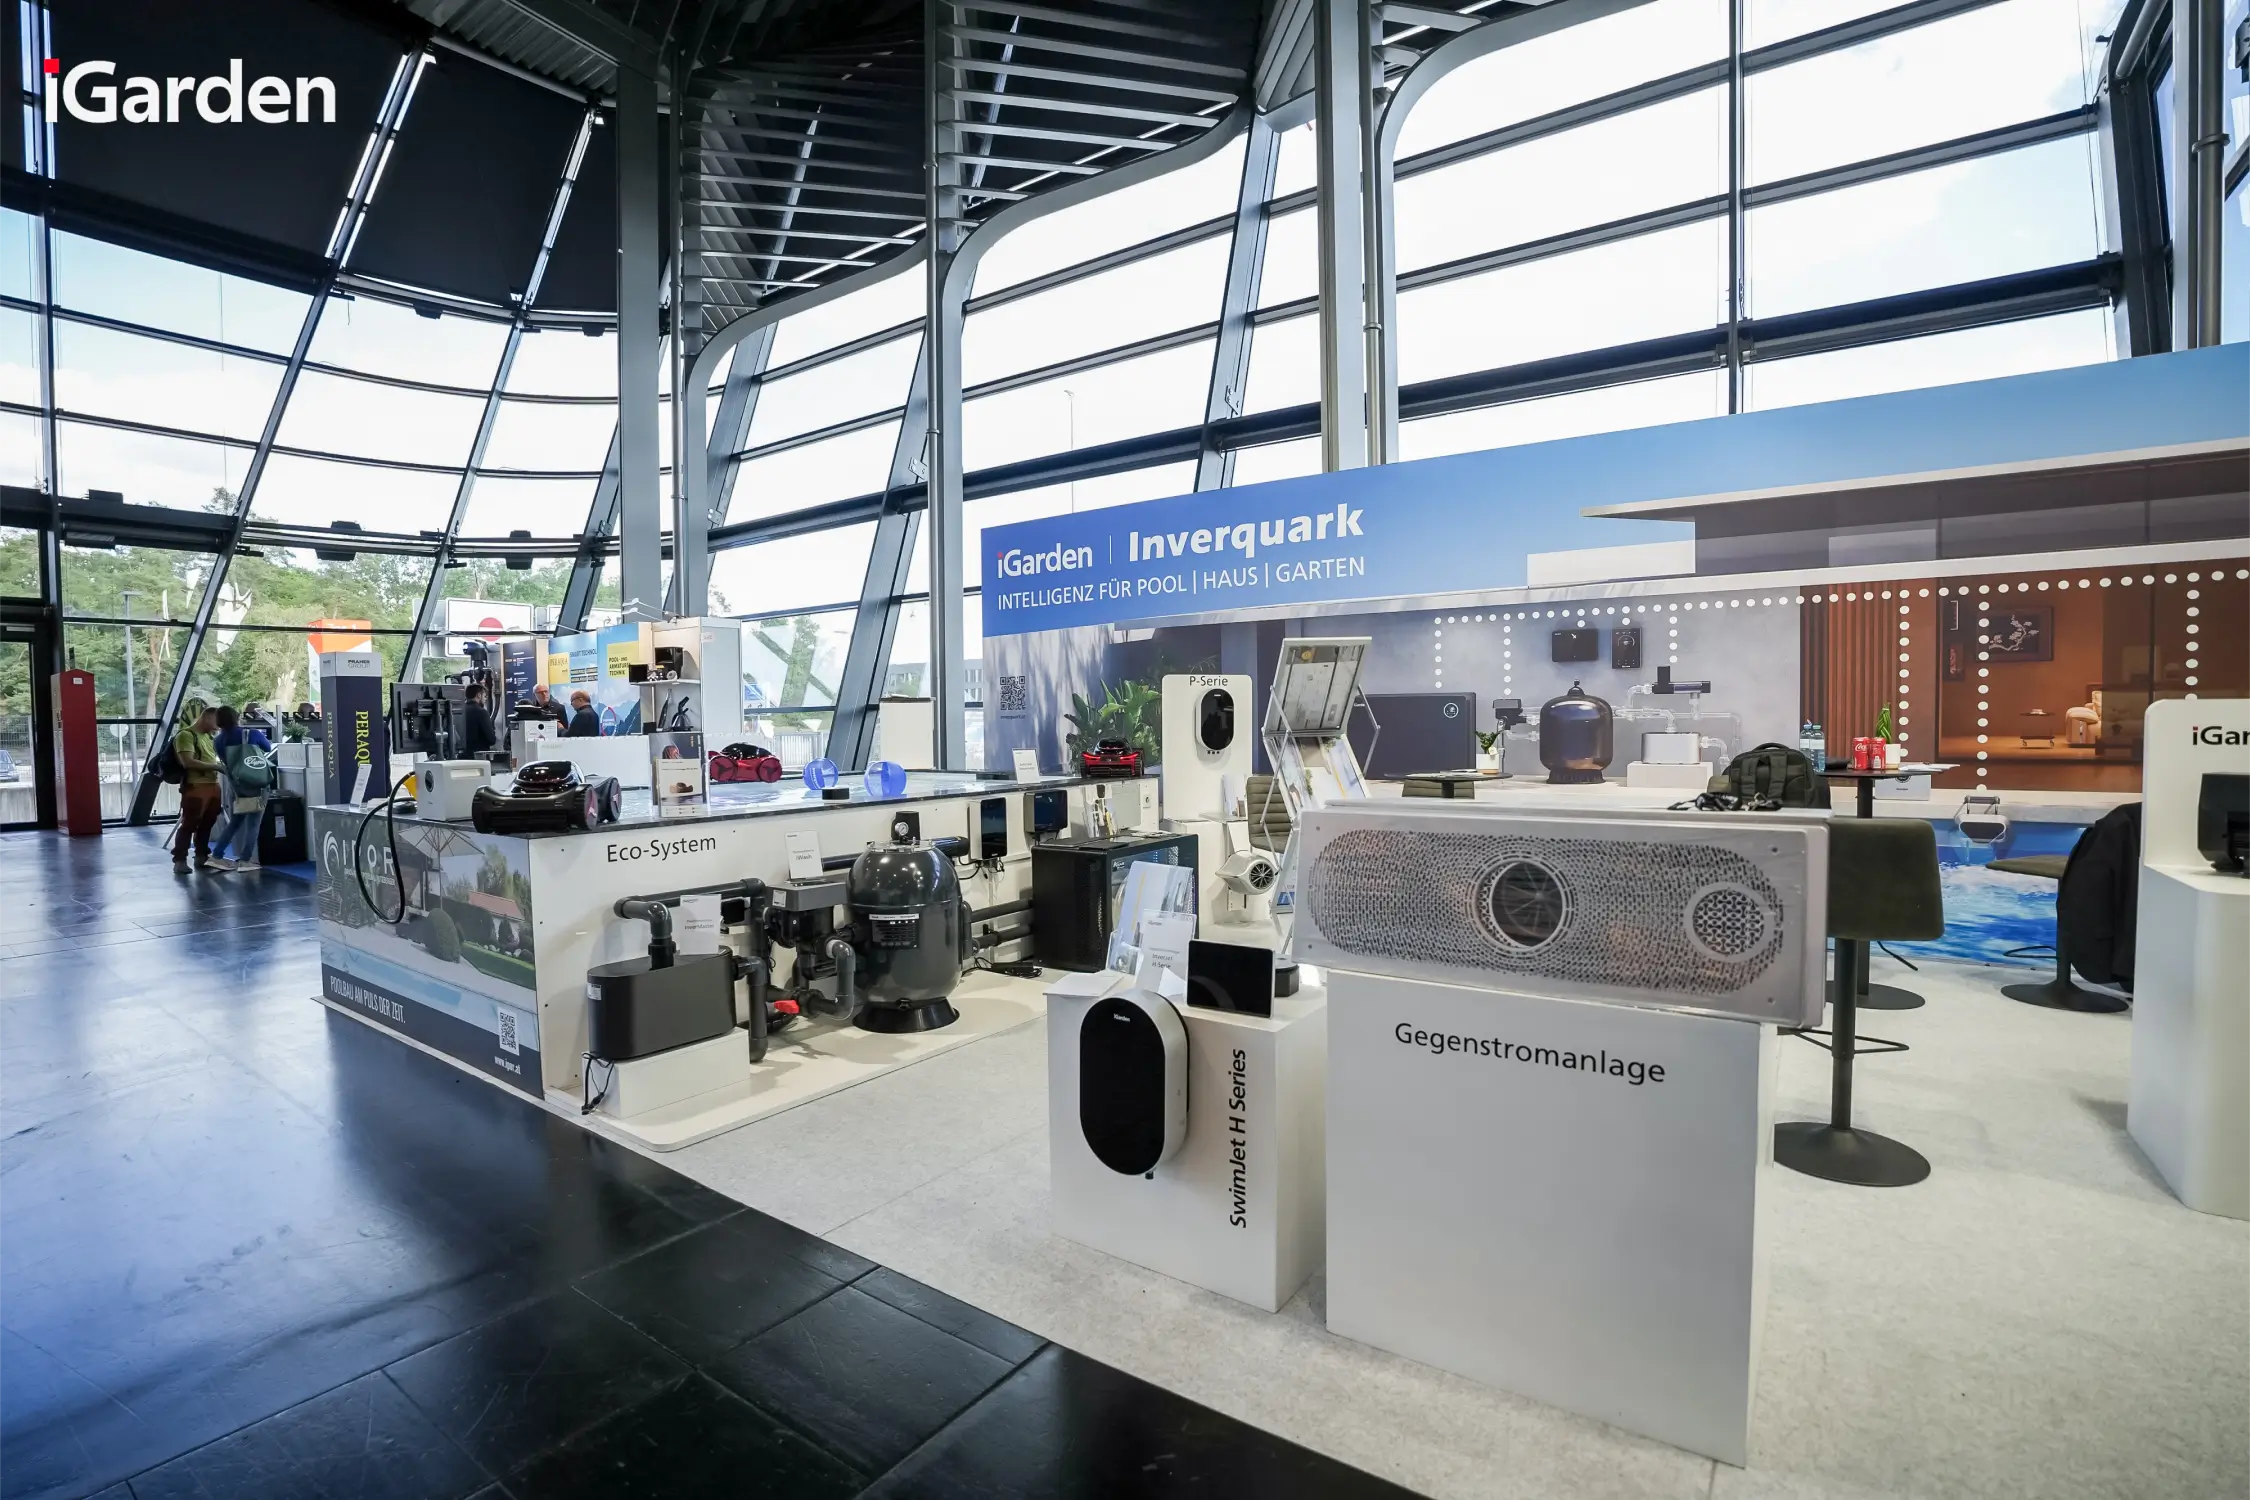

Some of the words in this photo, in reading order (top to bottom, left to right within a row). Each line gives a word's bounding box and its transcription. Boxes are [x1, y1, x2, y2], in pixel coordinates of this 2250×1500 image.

[997, 542, 1093, 579] iGarden
[1129, 503, 1364, 562] Inverquark
[998, 584, 1094, 611] INTELLIGENZ
[1100, 578, 1132, 600] FÜR
[1137, 574, 1188, 596] POOL
[1204, 566, 1258, 590] HAUS
[1276, 556, 1365, 583] GARTEN
[1189, 675, 1229, 687] P-Serie
[326, 711, 336, 779] PERAQUA
[355, 710, 372, 768] PERAQU
[607, 837, 716, 862] Eco-System
[330, 975, 354, 1001] POOLBAU
[354, 985, 364, 1005] AM
[363, 989, 379, 1012] PULS
[379, 995, 391, 1018] DER
[391, 1001, 406, 1024] ZEIT.
[1228, 1048, 1246, 1112] Series
[1394, 1022, 1666, 1086] Gegenstromanlage
[1228, 1116, 1246, 1134] H
[1228, 1138, 1247, 1229] SwimJet
